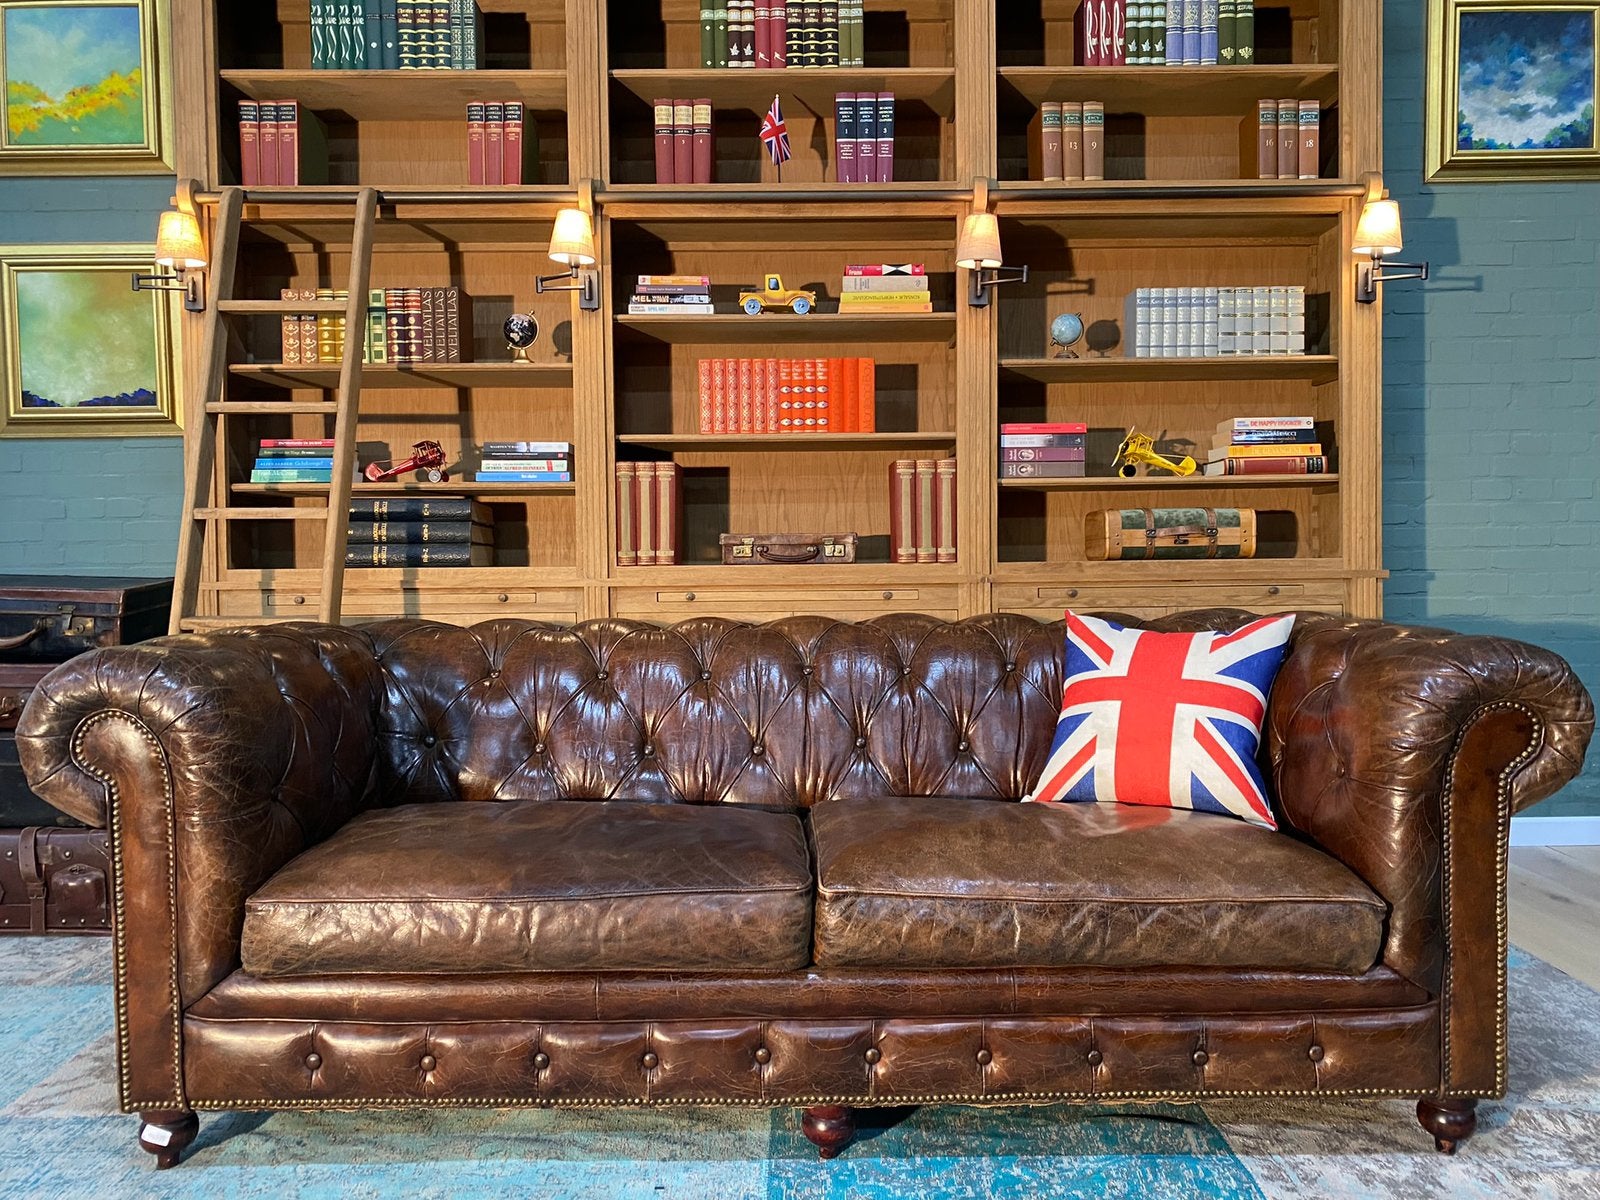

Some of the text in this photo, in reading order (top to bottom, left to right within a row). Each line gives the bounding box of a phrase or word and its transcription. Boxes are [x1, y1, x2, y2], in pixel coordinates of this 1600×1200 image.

[422, 290, 433, 359] WELTATLAS
[434, 290, 446, 359] WELTATLAS
[447, 290, 458, 359] WELTATLAS
[632, 295, 651, 303] MEL
